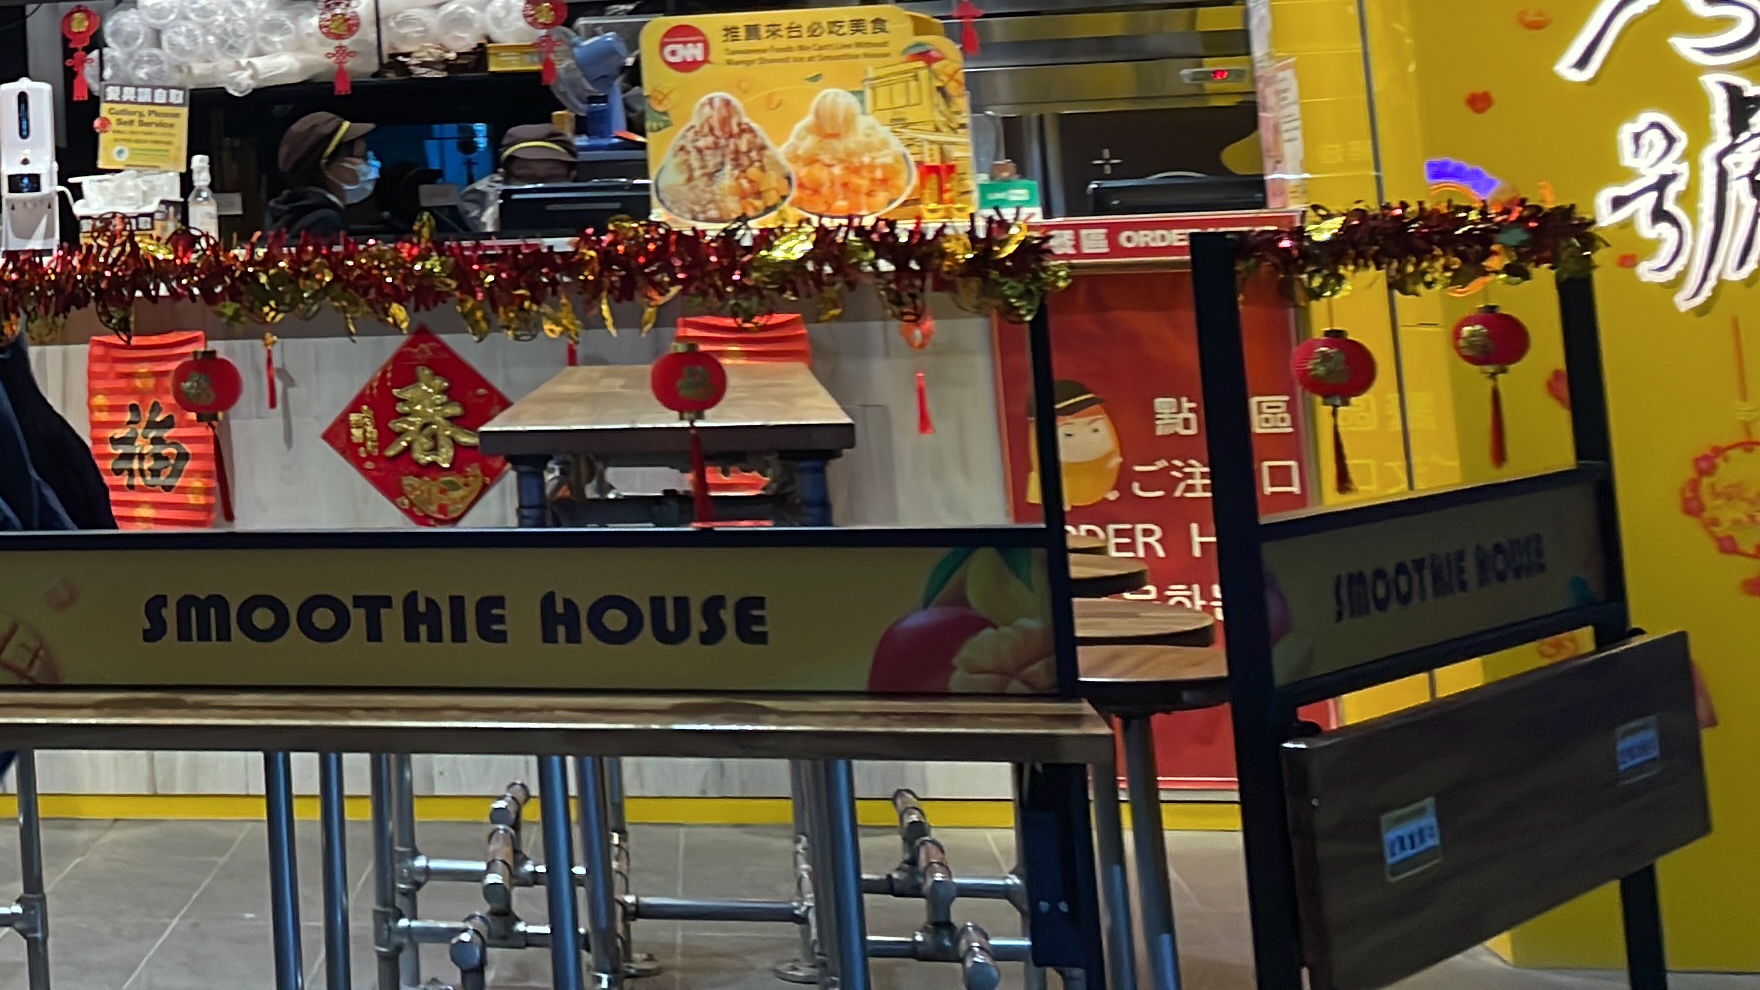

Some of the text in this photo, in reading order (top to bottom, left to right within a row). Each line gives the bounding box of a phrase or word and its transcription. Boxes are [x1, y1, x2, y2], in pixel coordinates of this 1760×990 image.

[663, 43, 705, 63] CNN
[1048, 228, 1110, 256] 餐區
[1118, 229, 1190, 249] ORDE
[383, 365, 480, 469] 春
[1334, 549, 1469, 624] SMOOTHIE
[142, 589, 770, 647] SMOOTHIE HOUSE
